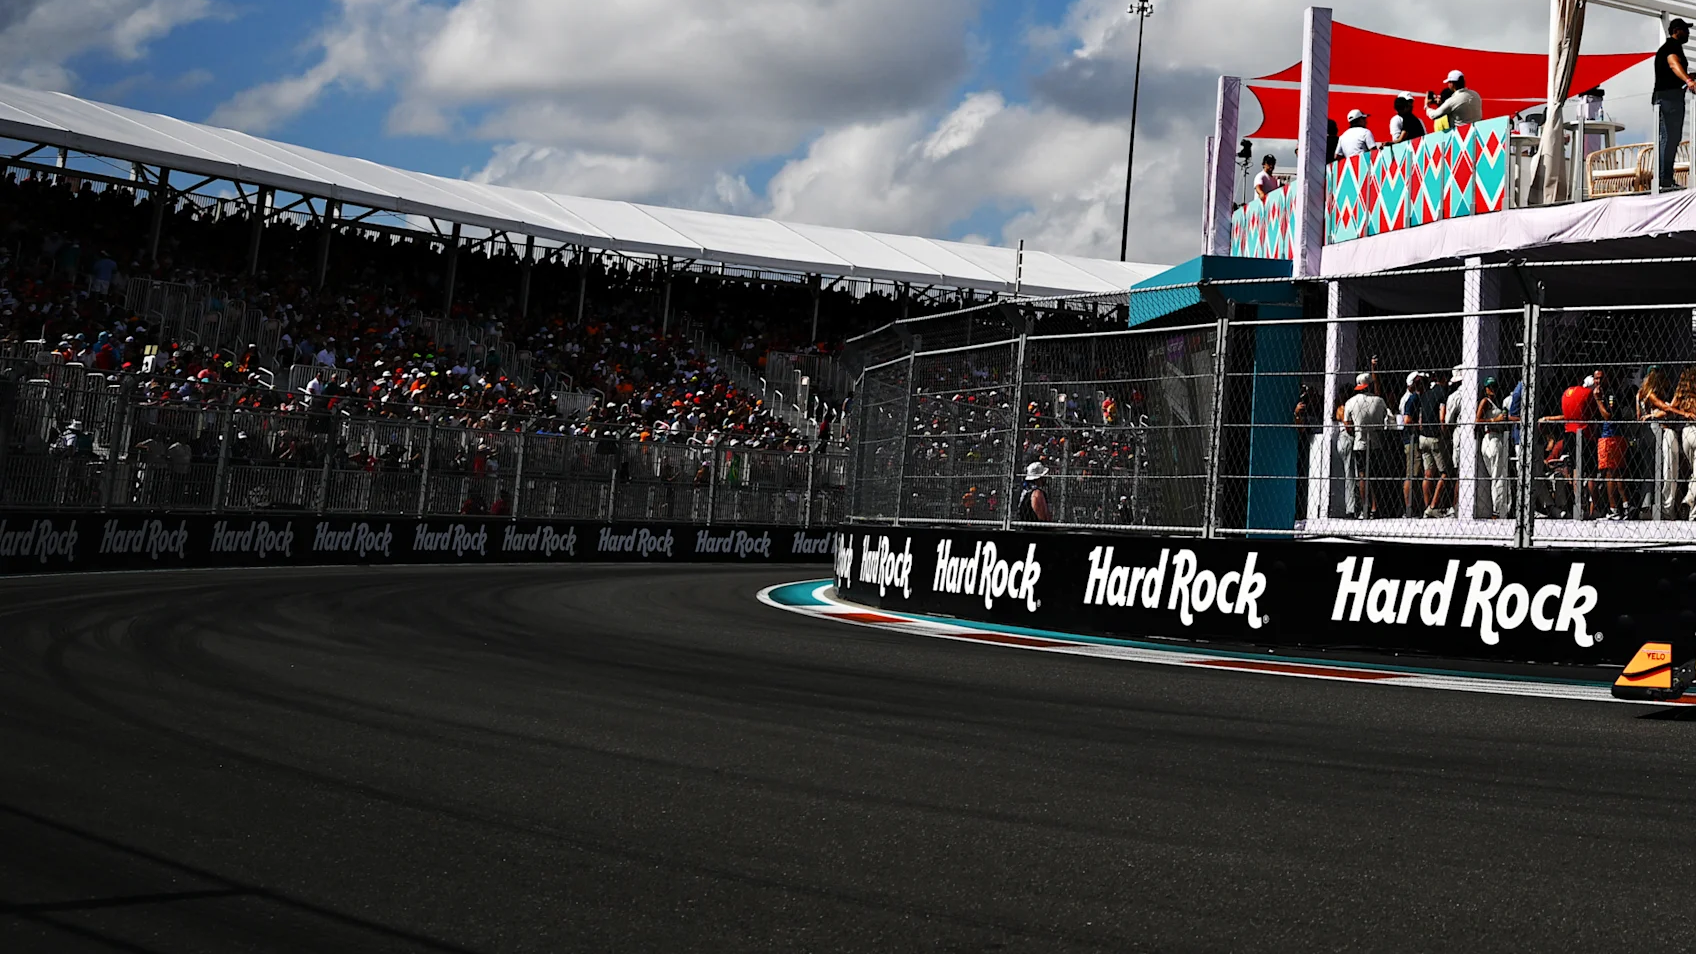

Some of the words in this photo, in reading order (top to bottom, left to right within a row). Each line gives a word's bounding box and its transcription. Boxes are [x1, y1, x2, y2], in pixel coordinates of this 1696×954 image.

[34, 519, 78, 564] Rock
[99, 519, 148, 553] Hard
[147, 519, 188, 560] Rock
[210, 520, 256, 552] Hard
[254, 520, 294, 558] Rock
[313, 522, 356, 551] Hard
[354, 522, 393, 557] Rock
[413, 523, 454, 551] Hard
[452, 523, 488, 557] Rock
[502, 525, 542, 551] Hard
[540, 525, 577, 556] Rock
[598, 527, 638, 552] Hard
[636, 528, 674, 557] Rock
[695, 529, 736, 553] Hard
[734, 530, 772, 558] Rock
[792, 531, 832, 553] Hard
[859, 534, 882, 584] Hard
[879, 536, 912, 599] Rock
[933, 538, 982, 596] Hard
[979, 541, 1041, 613] Rock
[1083, 546, 1169, 609] Hard
[1167, 548, 1267, 629] Rock
[1331, 556, 1460, 628] Hard
[1460, 560, 1598, 647] Rock
[1646, 652, 1666, 661] VELO
